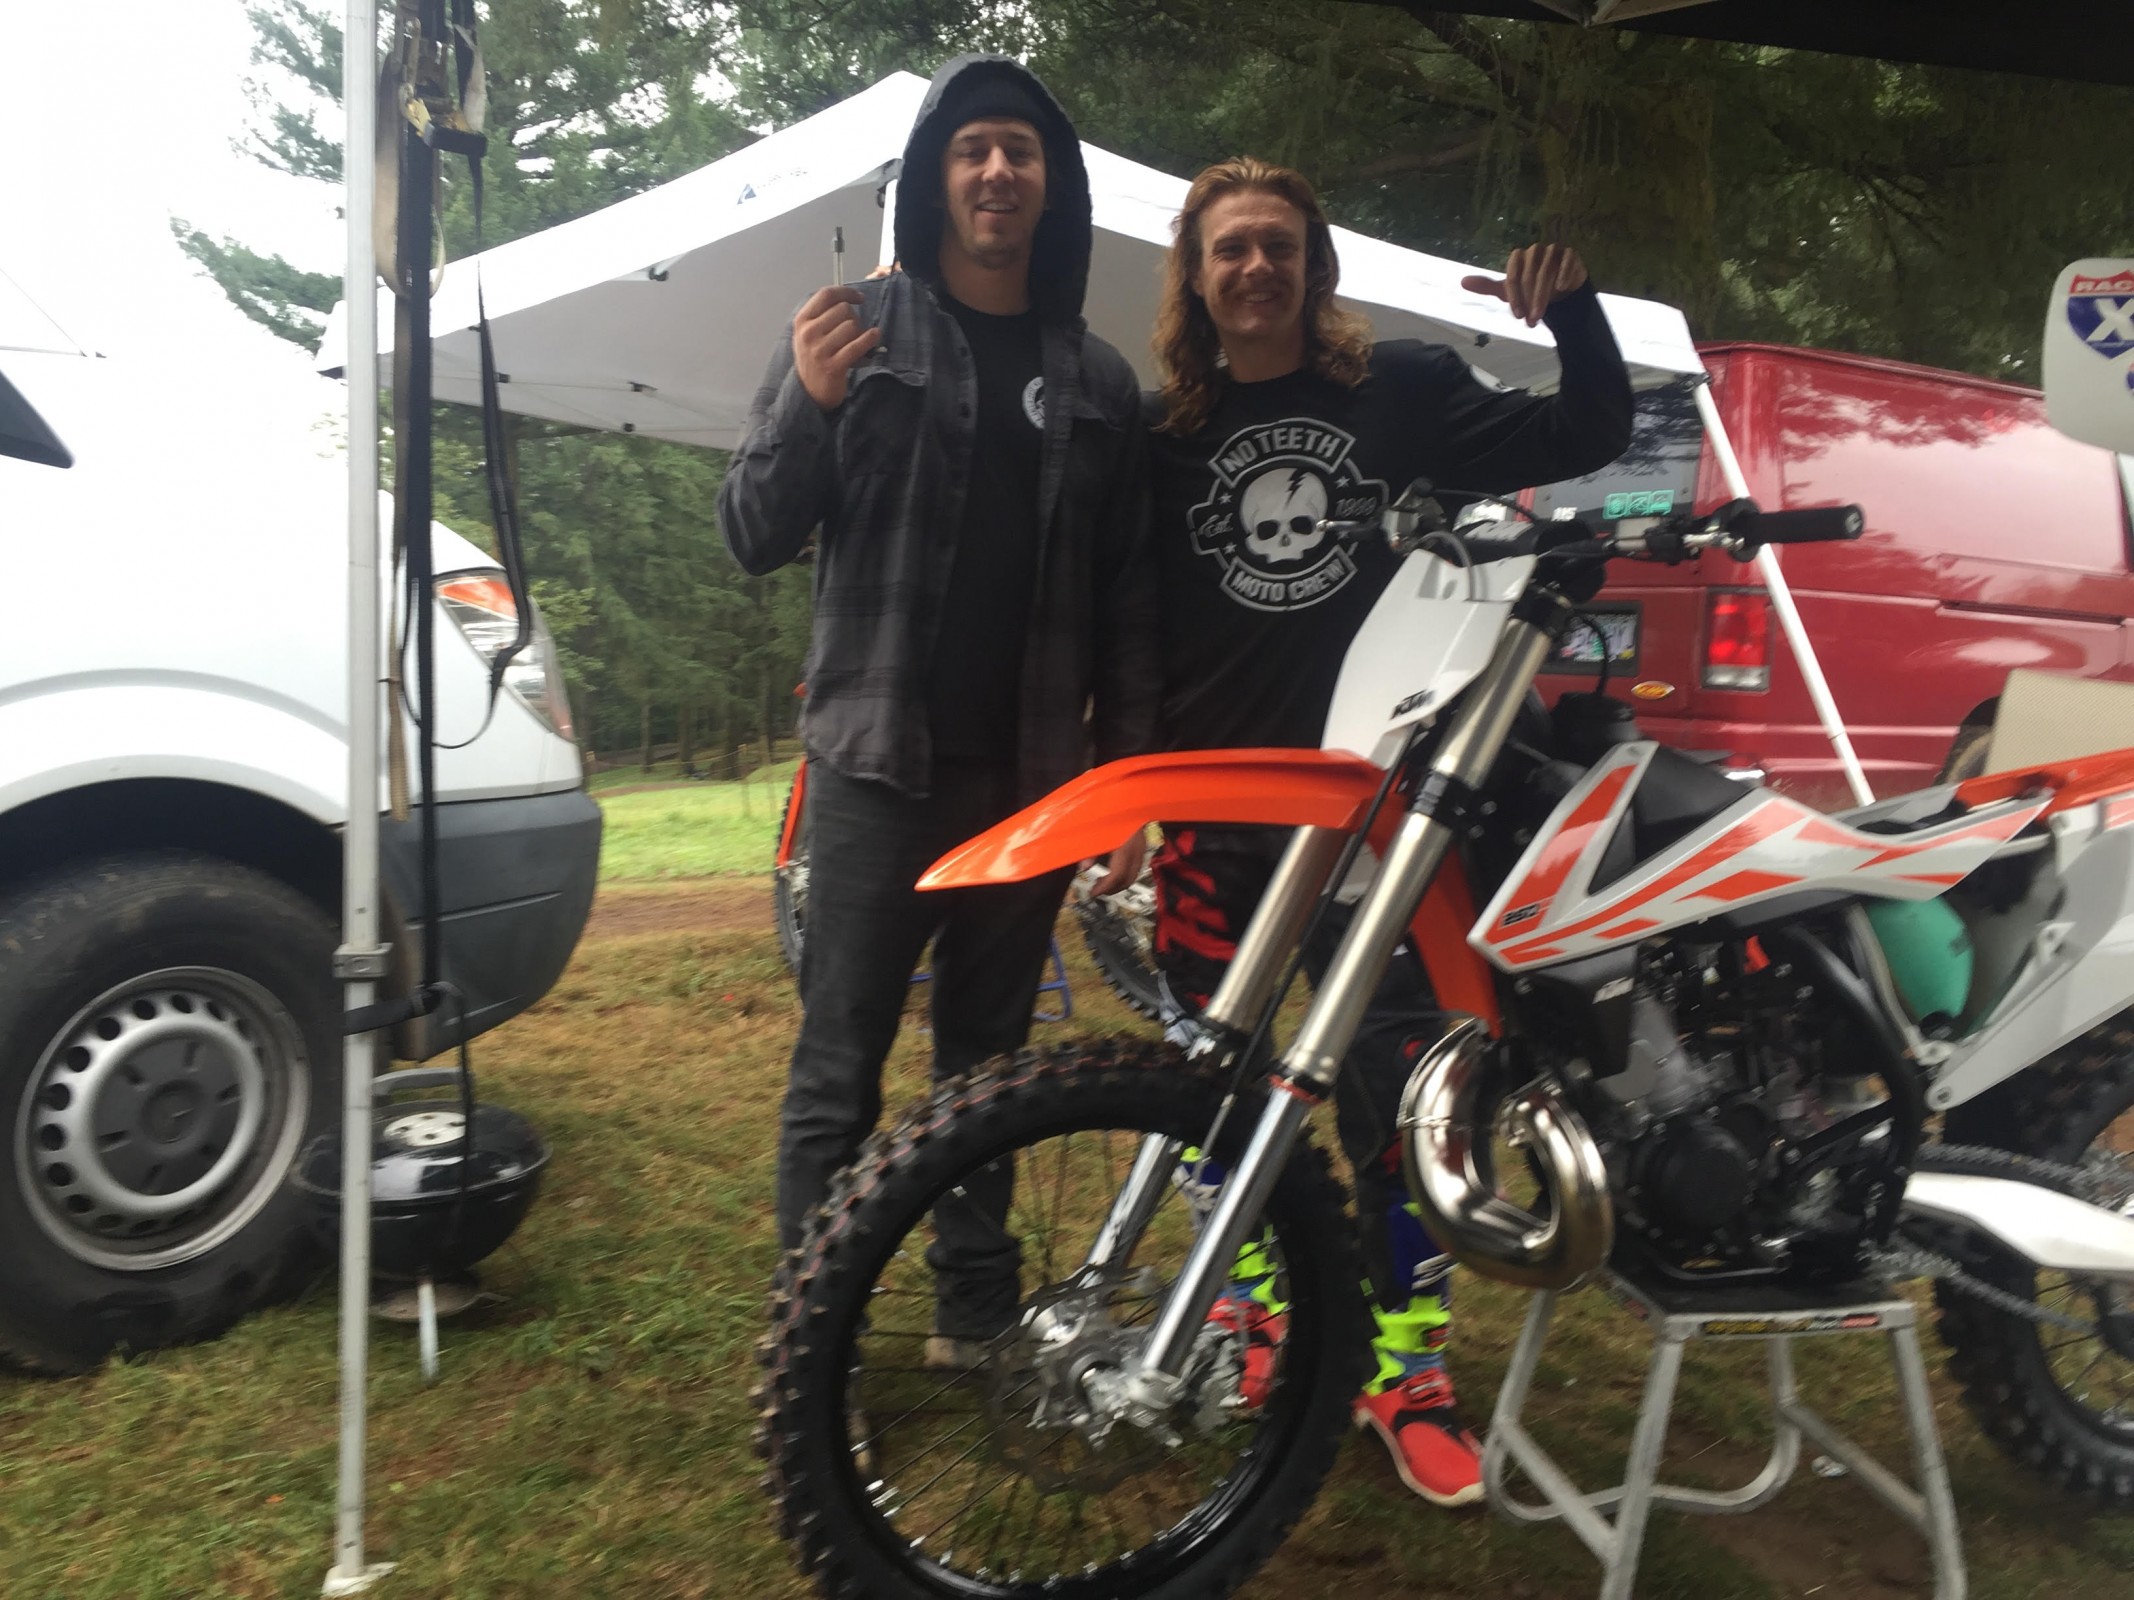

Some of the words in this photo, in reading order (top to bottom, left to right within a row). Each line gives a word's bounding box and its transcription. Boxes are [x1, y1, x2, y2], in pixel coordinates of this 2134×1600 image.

[1220, 440, 1258, 473] NO
[1253, 427, 1341, 459] TEETH
[1230, 570, 1285, 602] MOTO
[1288, 558, 1345, 601] CREW
